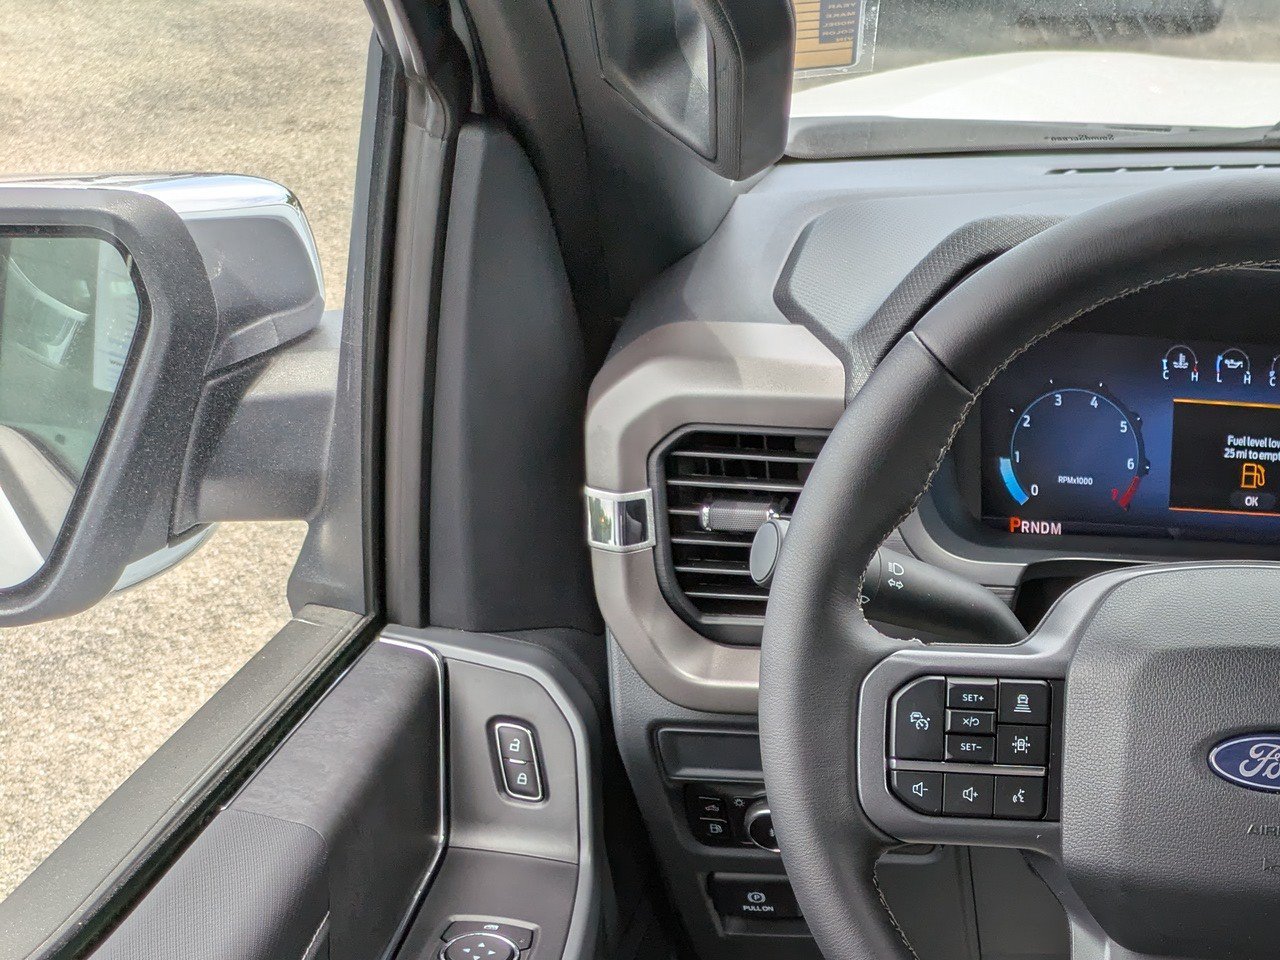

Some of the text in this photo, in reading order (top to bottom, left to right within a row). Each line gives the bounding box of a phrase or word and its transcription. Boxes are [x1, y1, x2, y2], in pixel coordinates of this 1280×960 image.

[1163, 370, 1169, 380] C
[1191, 372, 1199, 382] H
[1216, 373, 1222, 383] L
[1243, 374, 1251, 385] H
[1269, 377, 1276, 387] C
[1054, 394, 1062, 406] 3
[1090, 396, 1099, 409] 4
[1023, 415, 1031, 428] 2
[1119, 421, 1128, 433] 5
[1227, 435, 1247, 447] Fuel
[1247, 437, 1268, 448] level
[1014, 451, 1020, 463] 1
[1224, 449, 1235, 459] 25
[1236, 450, 1248, 460] mi
[1248, 451, 1259, 460] to
[1127, 458, 1135, 470] 6
[1057, 475, 1094, 486] RPMx1000
[1030, 484, 1039, 496] 0
[1244, 496, 1259, 507] OK
[962, 693, 985, 702] SET+
